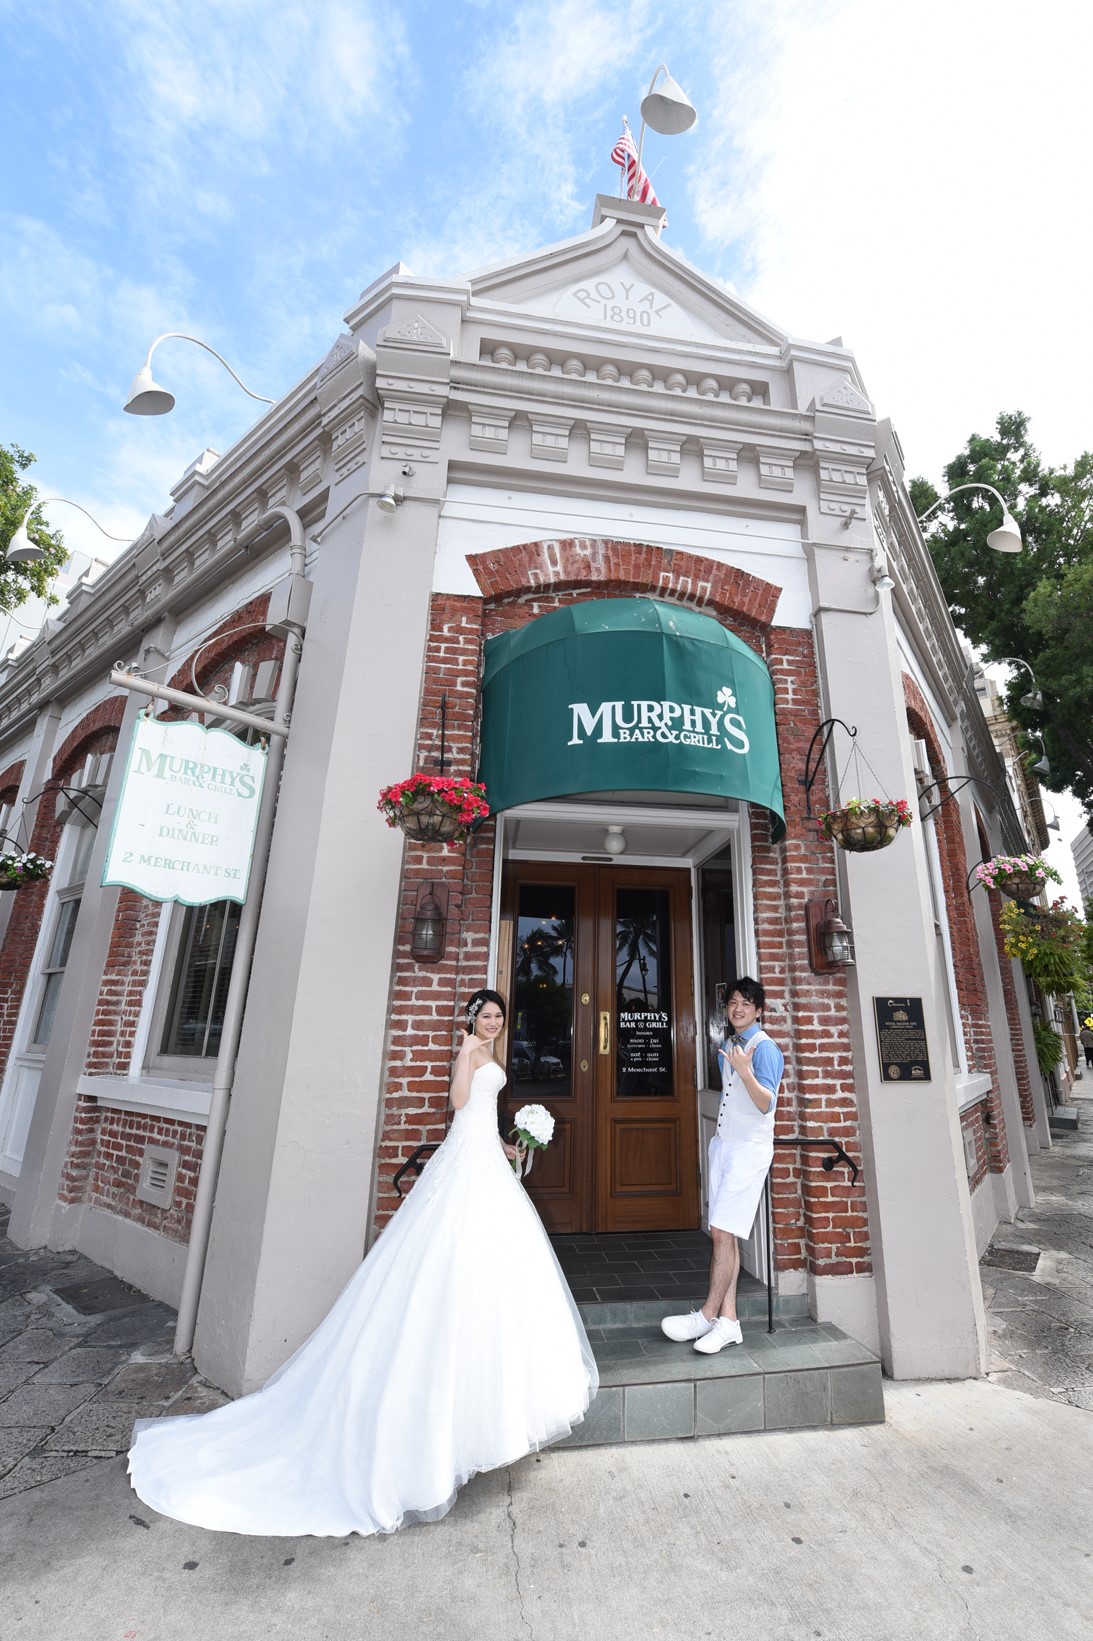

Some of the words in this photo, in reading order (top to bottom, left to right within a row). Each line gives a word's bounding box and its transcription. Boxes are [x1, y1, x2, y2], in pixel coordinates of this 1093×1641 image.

[572, 281, 672, 319] ROYAL
[603, 303, 652, 328] 1890
[618, 729, 655, 743] BAR
[680, 731, 722, 750] GRILL
[169, 774, 192, 787] BAR
[207, 782, 237, 797] GRILL
[164, 802, 220, 825] LUNCH
[185, 819, 197, 831] &
[157, 825, 220, 848] DINNER
[121, 851, 133, 864] 2
[139, 853, 224, 878] MERCHANT
[223, 867, 242, 880] ST.
[620, 1011, 668, 1021] MURPHY'S
